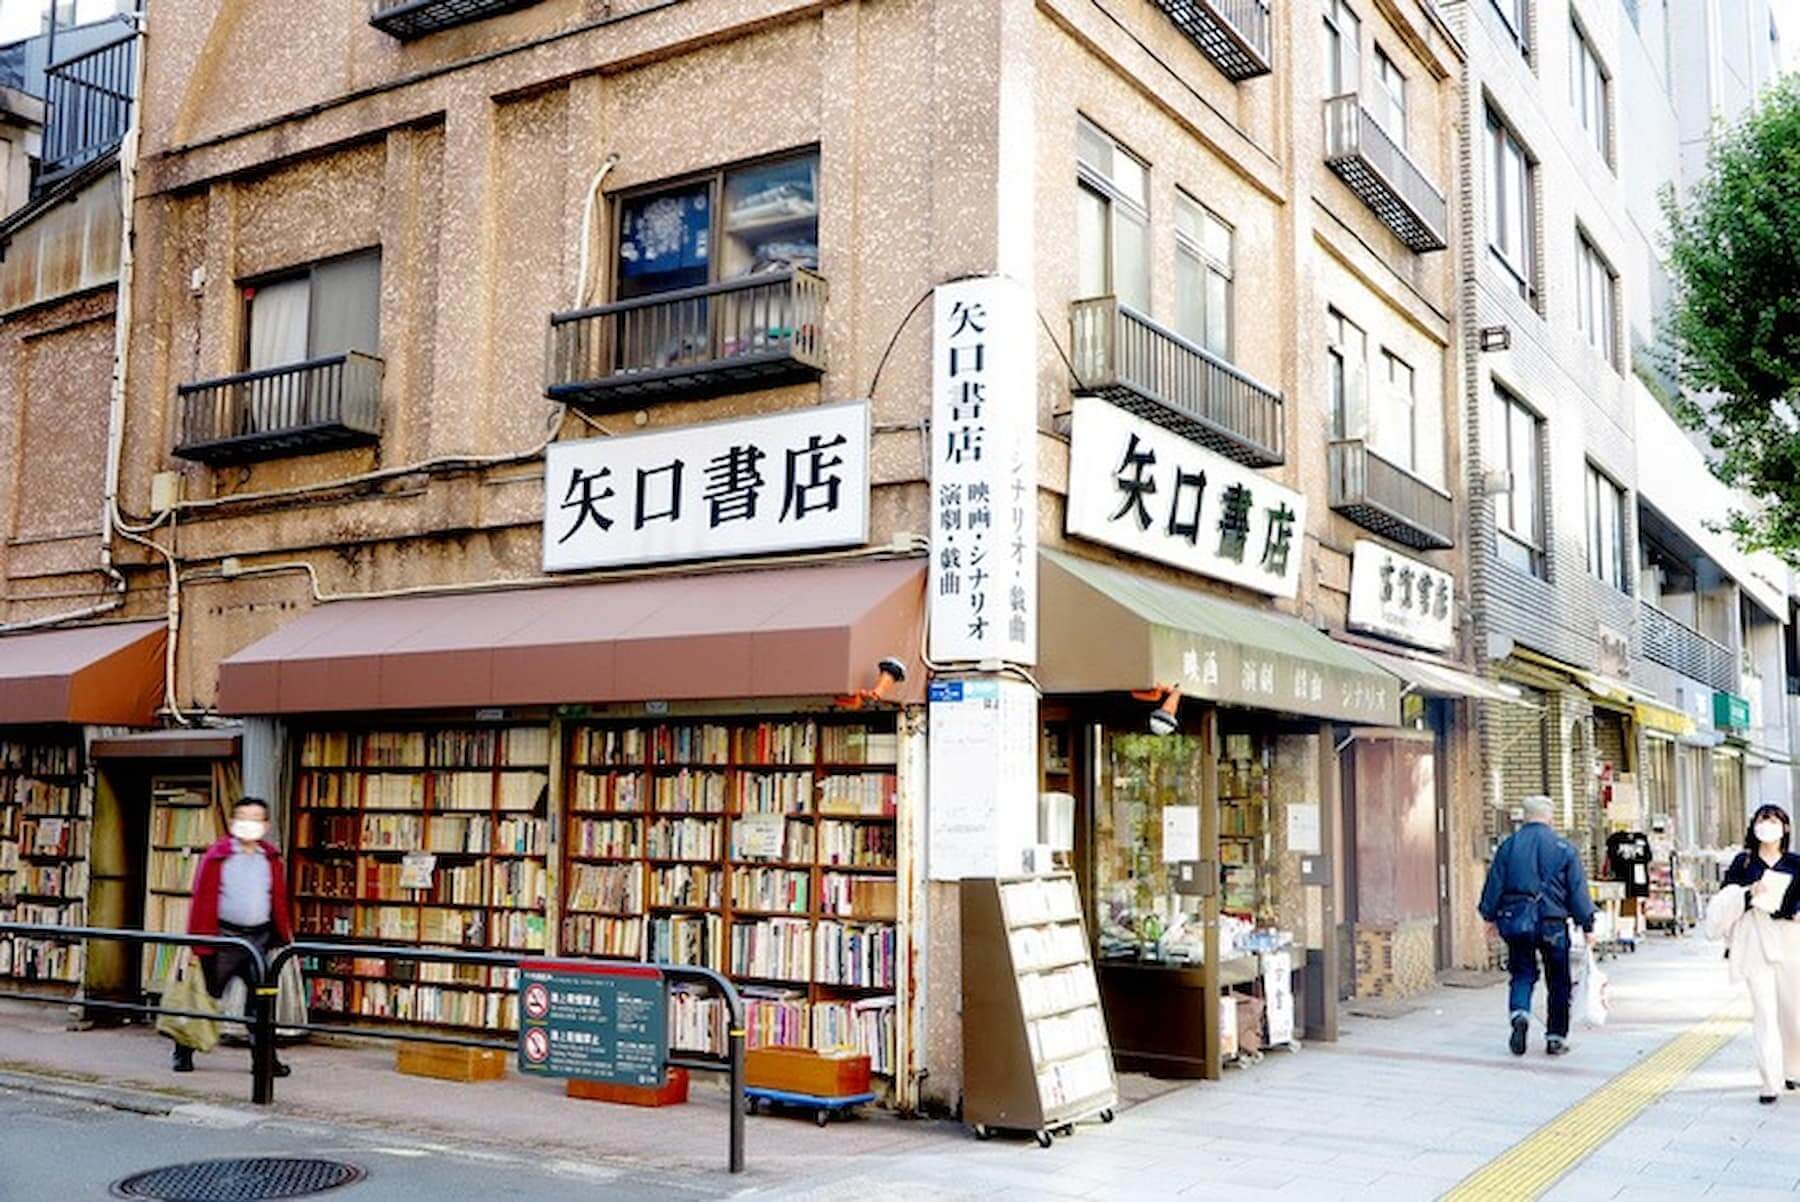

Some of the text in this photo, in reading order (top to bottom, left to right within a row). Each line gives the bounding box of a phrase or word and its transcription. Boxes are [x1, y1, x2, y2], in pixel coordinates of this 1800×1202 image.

[945, 301, 987, 465] 矢口書店
[558, 433, 848, 544] 矢口書店
[939, 483, 962, 597] 演劇・戯曲
[967, 480, 991, 640] 映画・シナリオ
[1107, 432, 1295, 578] 矢口書店
